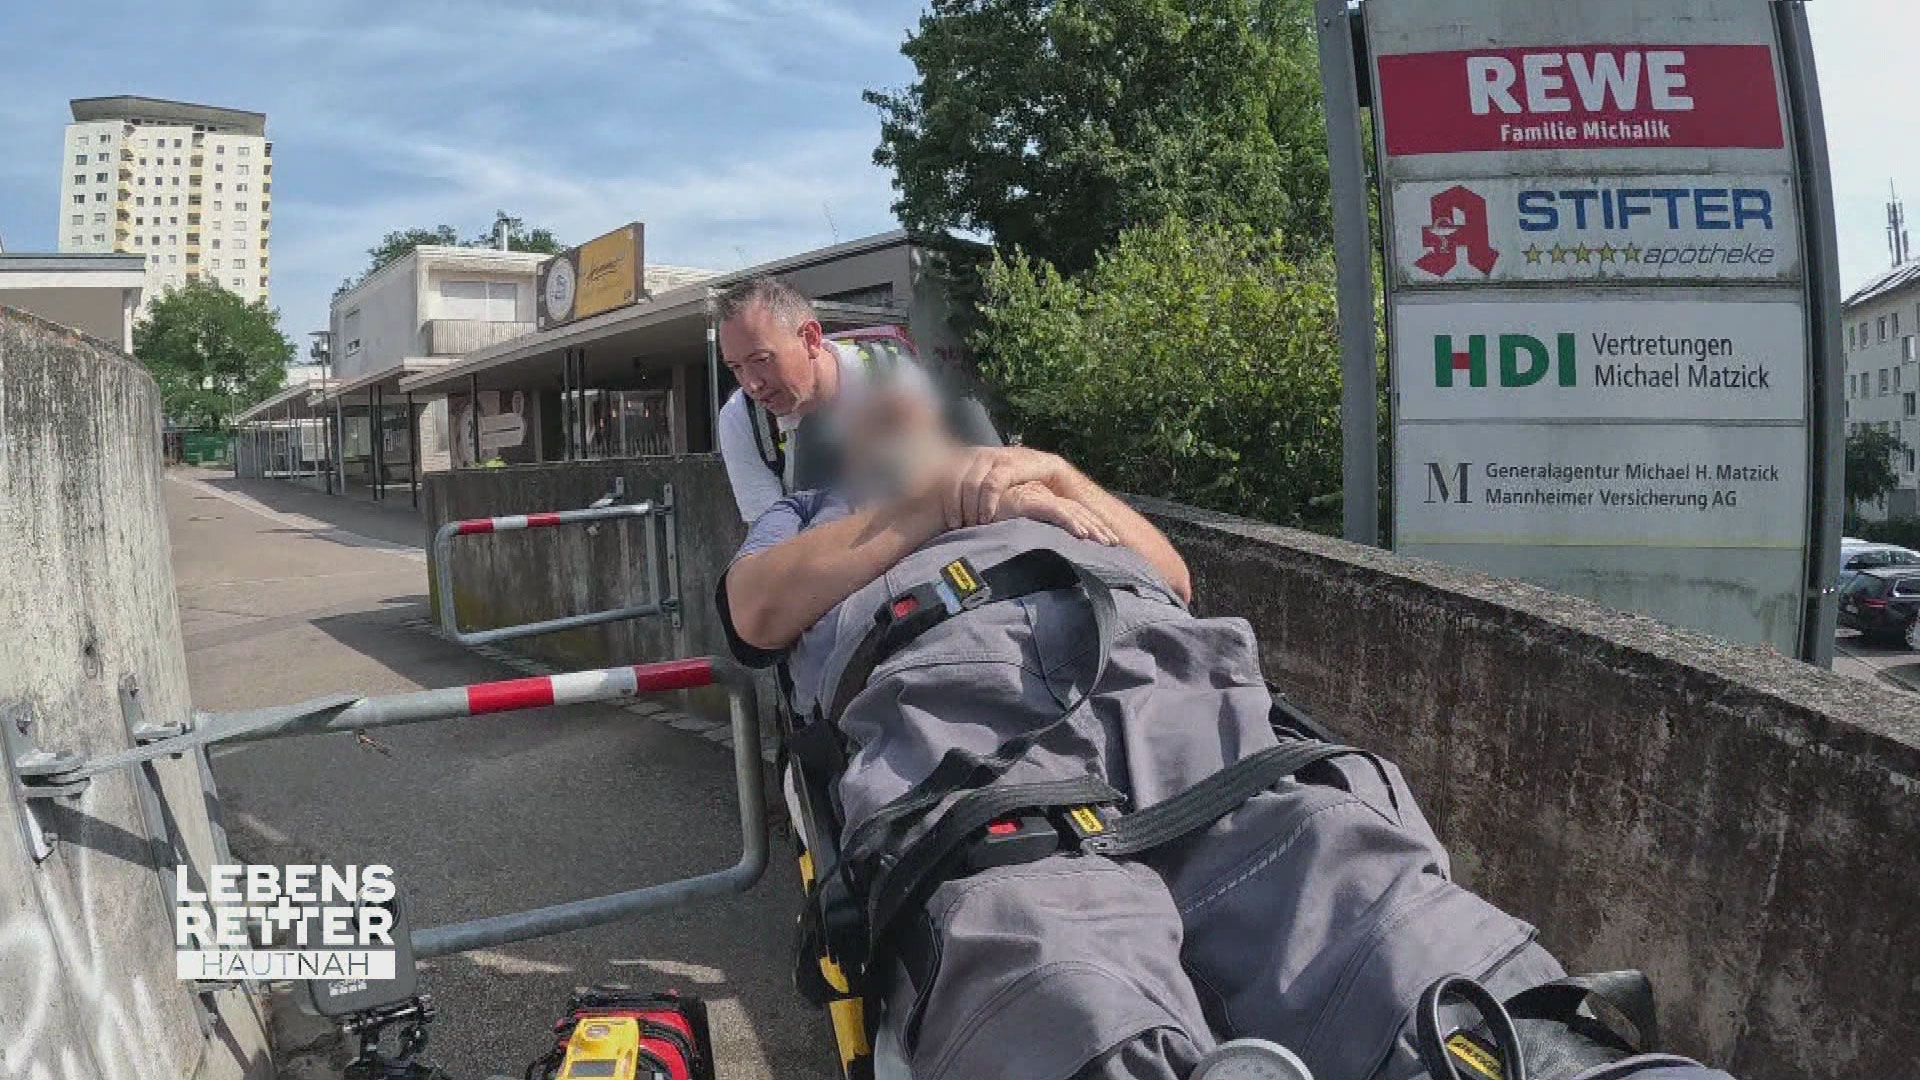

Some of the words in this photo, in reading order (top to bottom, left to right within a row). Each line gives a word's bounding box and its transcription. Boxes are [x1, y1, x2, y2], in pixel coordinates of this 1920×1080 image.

[1466, 50, 1695, 116] REWE
[1500, 122, 1577, 142] Familie
[1583, 119, 1671, 141] Michalik
[1517, 187, 1773, 231] STIFTER
[1643, 241, 1775, 269] apotheke
[1434, 332, 1577, 388] HDI
[1592, 332, 1733, 361] Vertretungen
[1594, 364, 1680, 388] Michael
[1688, 364, 1770, 388] Matzick
[1423, 461, 1473, 504] M
[1485, 462, 1620, 483] Generalagentur
[1625, 463, 1690, 481] Michael
[1695, 464, 1713, 481] H.
[1716, 464, 1780, 482] Matzick
[1485, 488, 1594, 506] Mannheimer
[1599, 489, 1707, 511] Versicherung
[1712, 490, 1737, 508] AG
